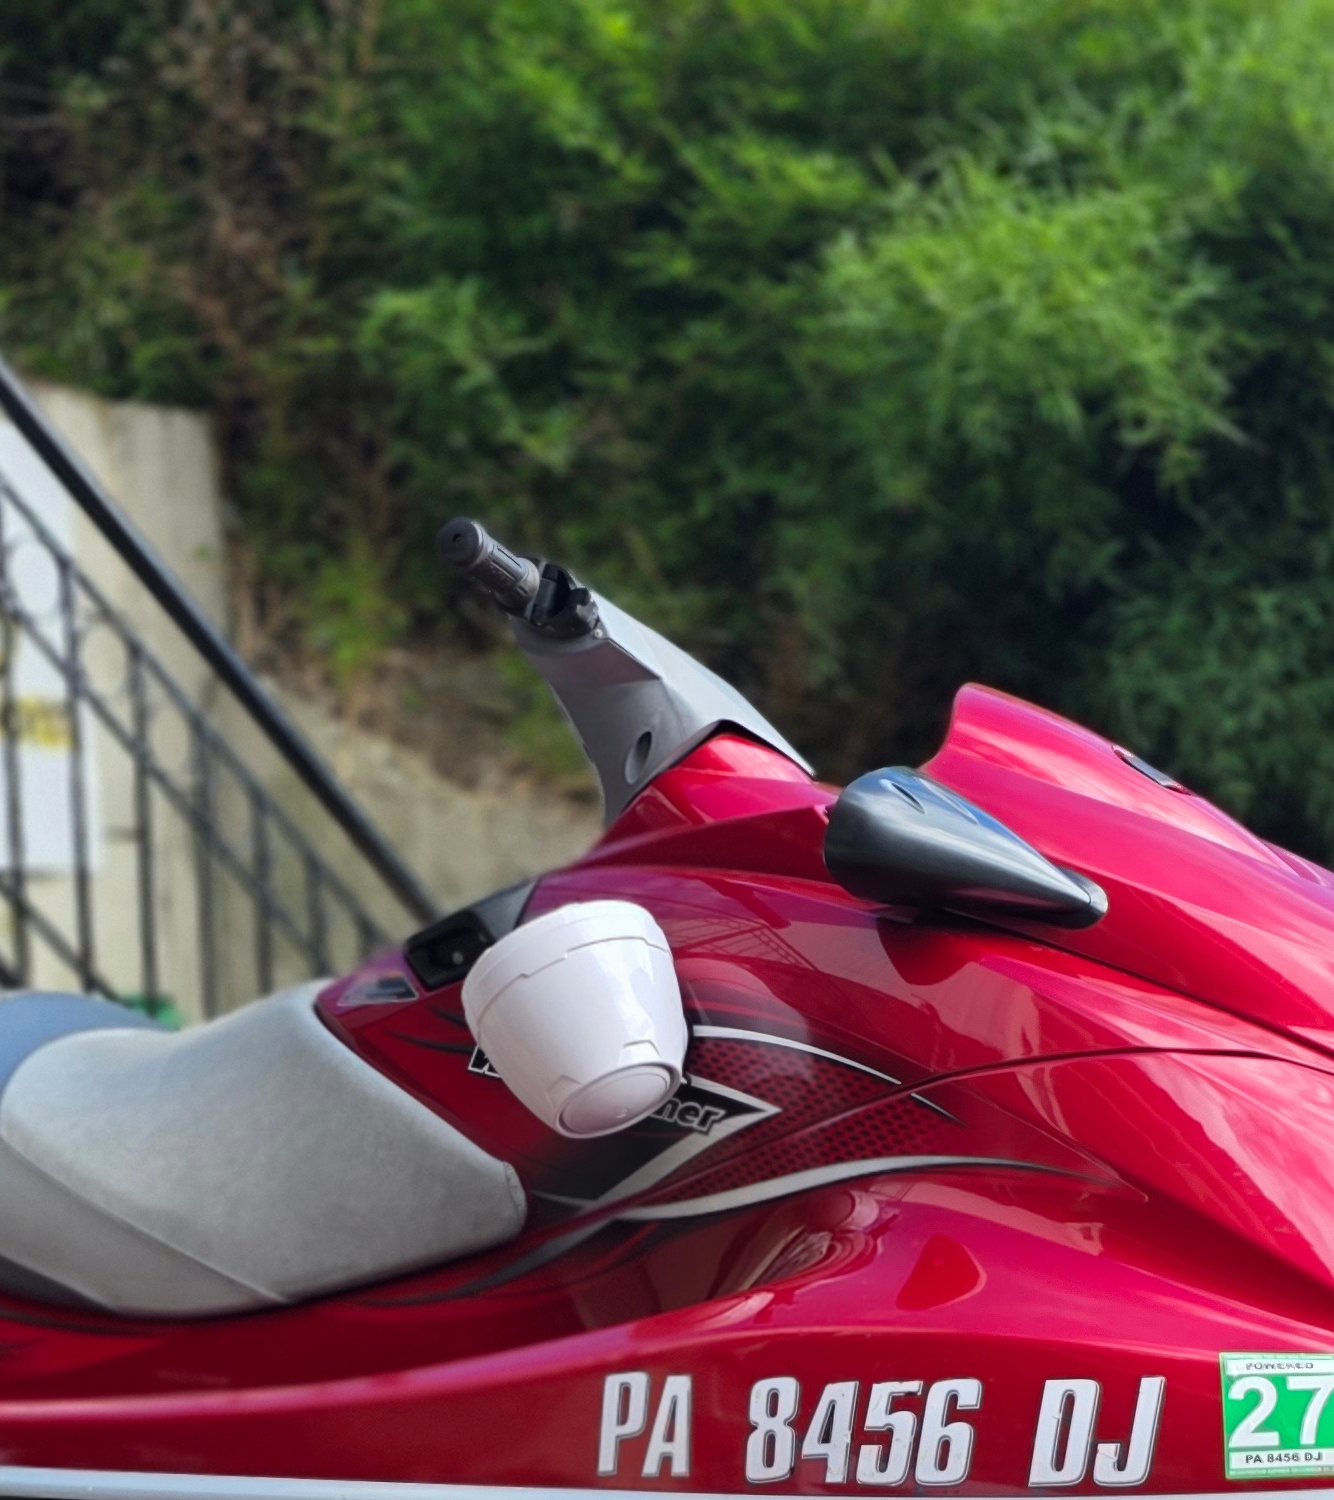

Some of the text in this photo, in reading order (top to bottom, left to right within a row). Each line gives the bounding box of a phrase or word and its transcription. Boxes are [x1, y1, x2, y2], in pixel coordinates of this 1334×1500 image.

[597, 1371, 1166, 1488] PA 8456 DJ
[1245, 1452, 1323, 1464] PA 8456 DJ
